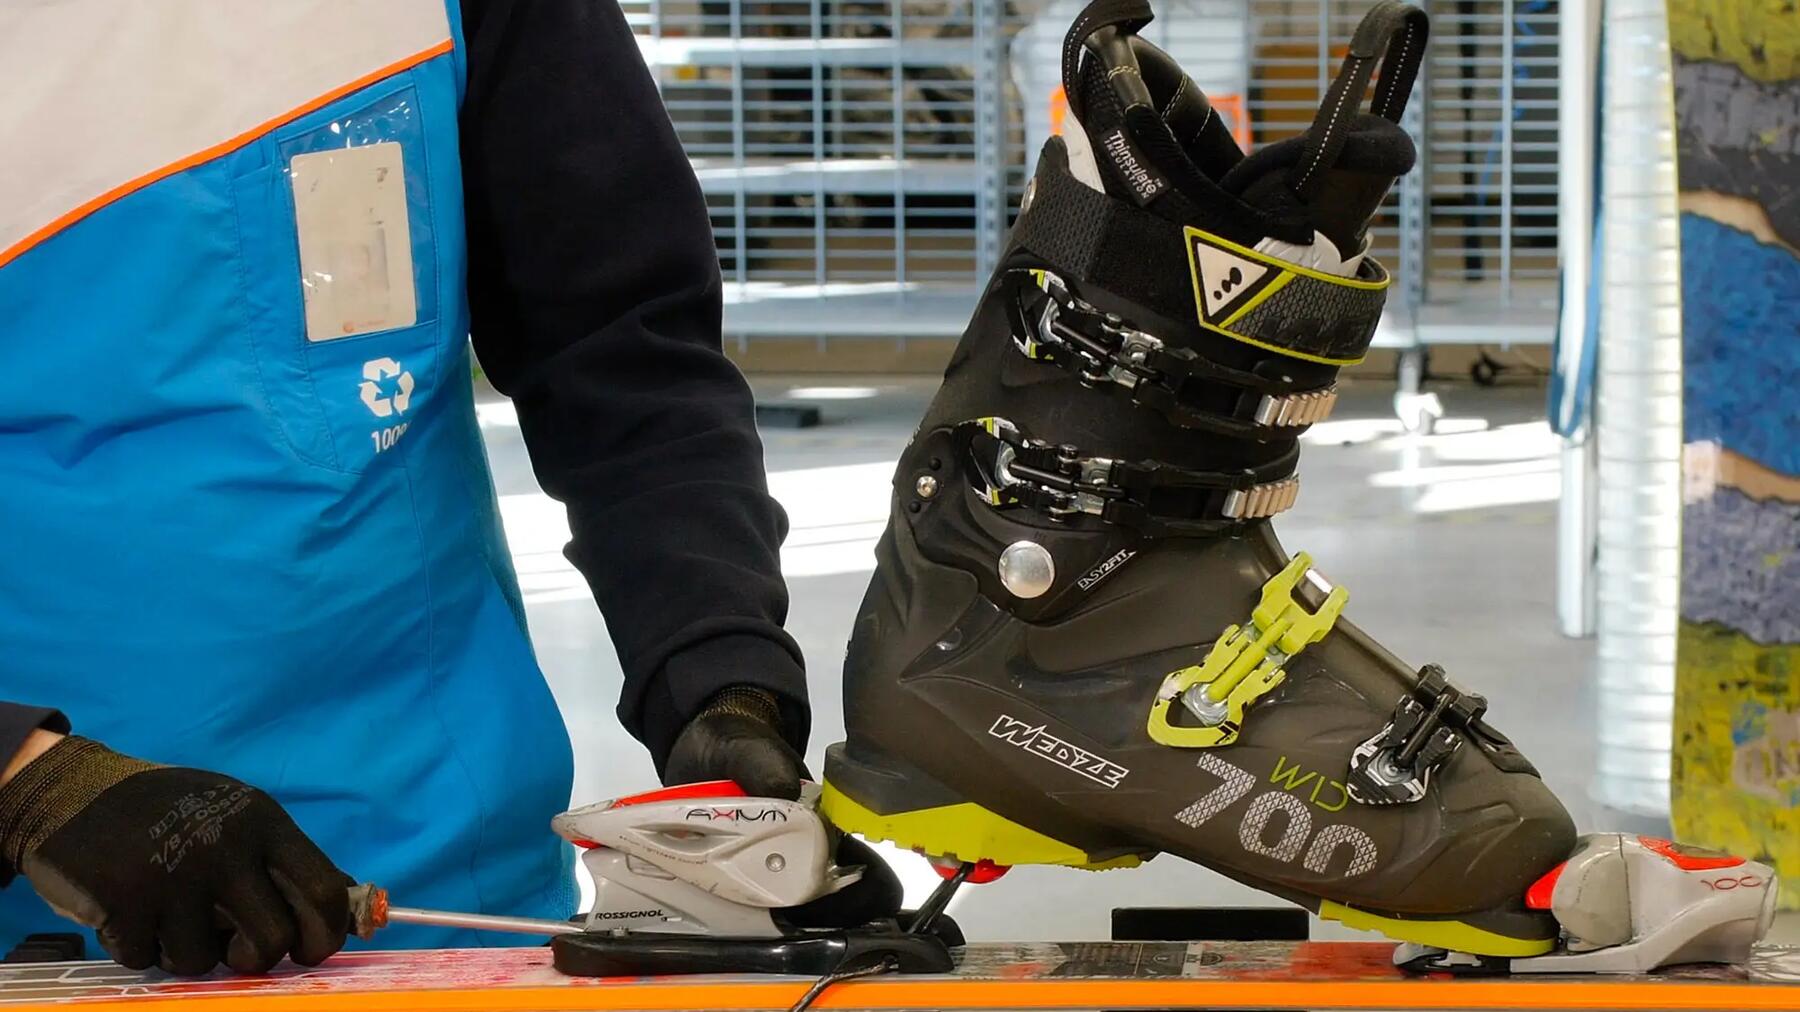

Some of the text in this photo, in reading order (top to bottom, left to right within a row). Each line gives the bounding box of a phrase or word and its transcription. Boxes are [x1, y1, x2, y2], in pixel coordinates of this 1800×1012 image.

[1078, 549, 1127, 588] EASY2FIT
[1174, 752, 1377, 877] 700
[595, 910, 664, 920] ROSSIGNOL
